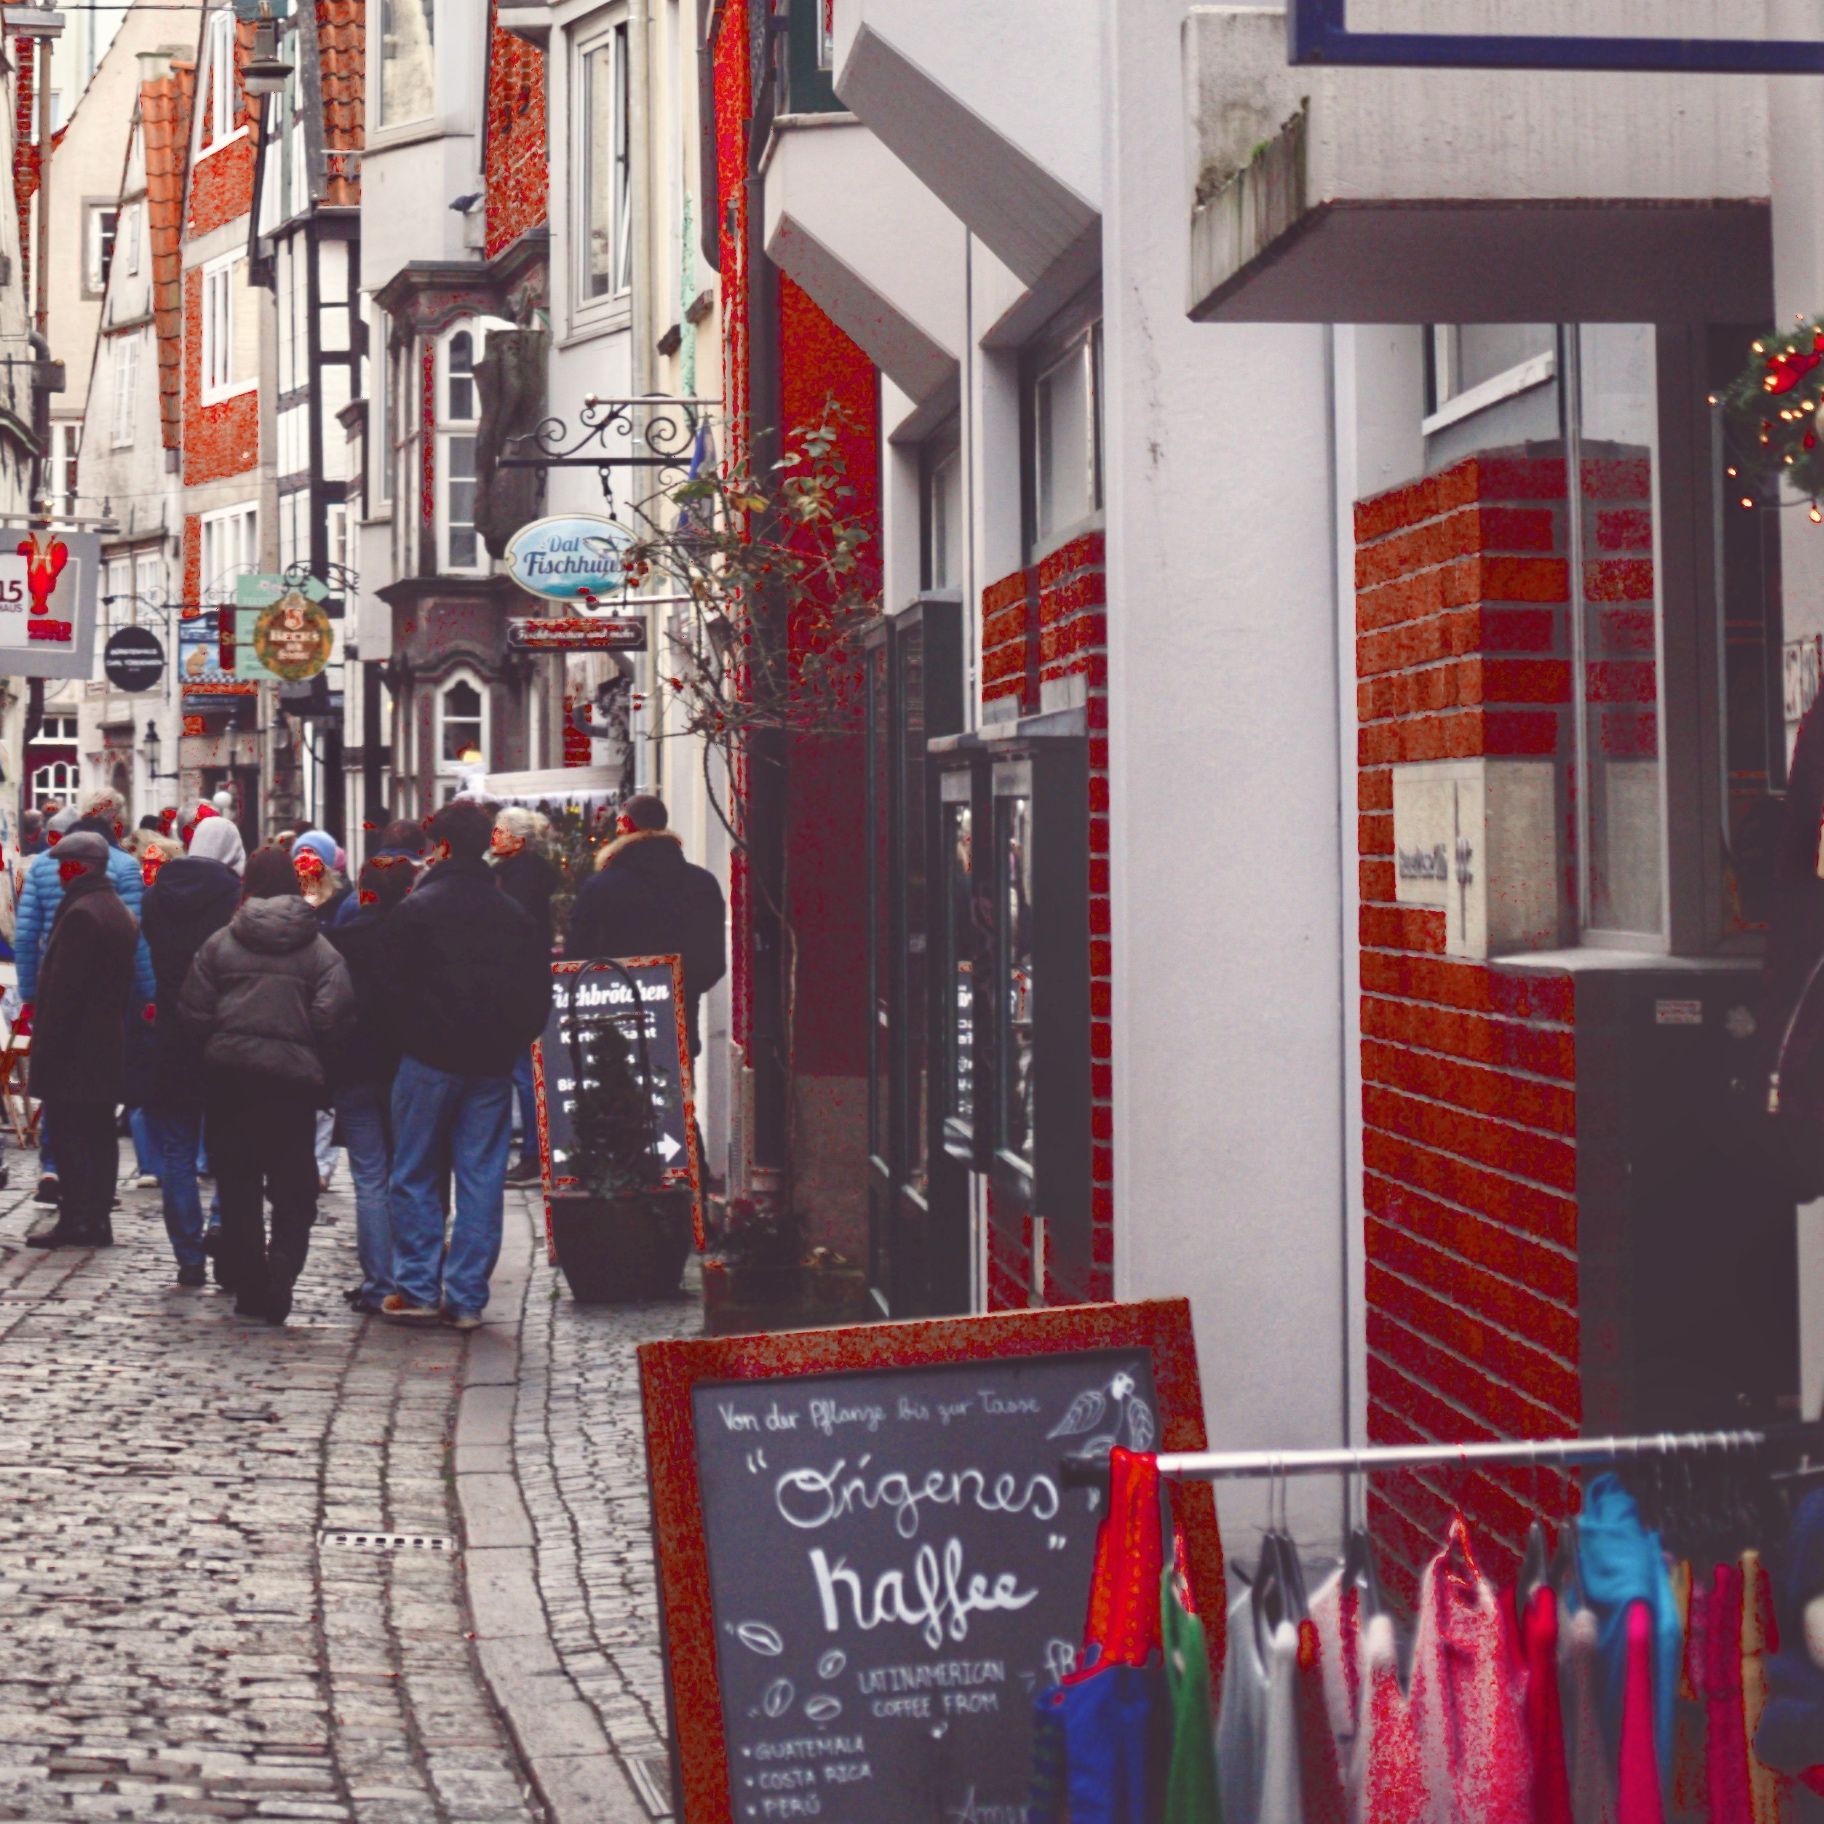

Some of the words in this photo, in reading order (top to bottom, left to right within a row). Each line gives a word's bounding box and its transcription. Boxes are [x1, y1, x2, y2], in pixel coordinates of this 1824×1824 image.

[718, 1403, 760, 1431] Von
[767, 1402, 799, 1431] der
[810, 1398, 887, 1436] Pflanze
[898, 1398, 929, 1421] bis
[938, 1402, 969, 1426] zur
[978, 1390, 1042, 1414] Tasse
[873, 1696, 931, 1718] COFFEE
[943, 1692, 999, 1715] FROM
[755, 1736, 865, 1760] GUATEMALA
[759, 1768, 816, 1790] COSTA
[824, 1761, 872, 1783] RICA
